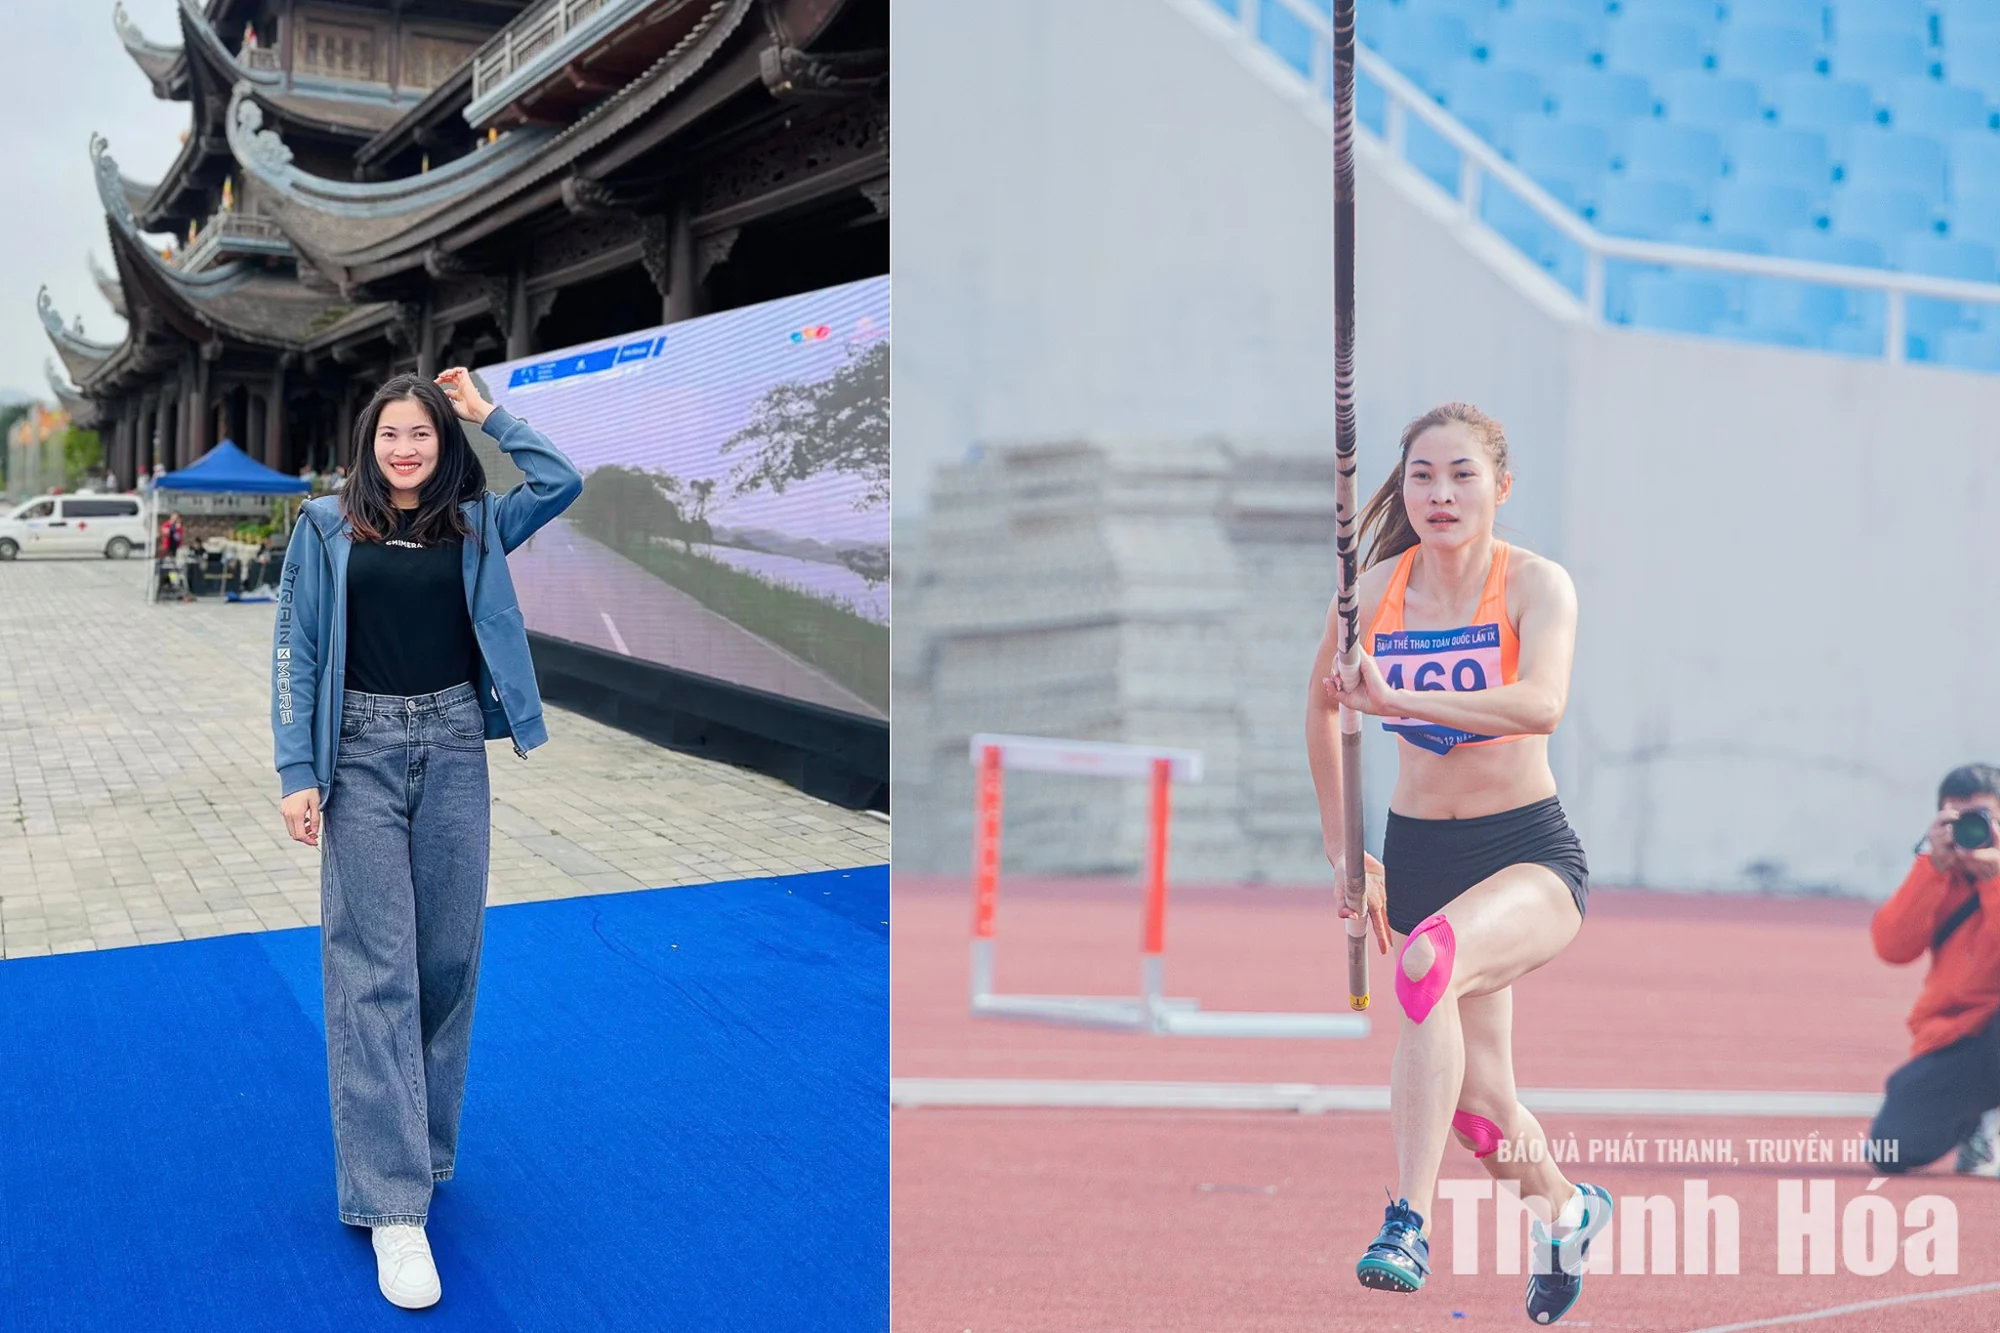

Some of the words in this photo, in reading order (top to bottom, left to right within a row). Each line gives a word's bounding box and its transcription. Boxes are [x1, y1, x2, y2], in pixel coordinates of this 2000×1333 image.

[279, 576, 296, 645] TRAIN
[1410, 639, 1431, 650] THAO
[1487, 630, 1496, 642] IX
[277, 662, 293, 725] MORE
[1443, 736, 1455, 747] 12
